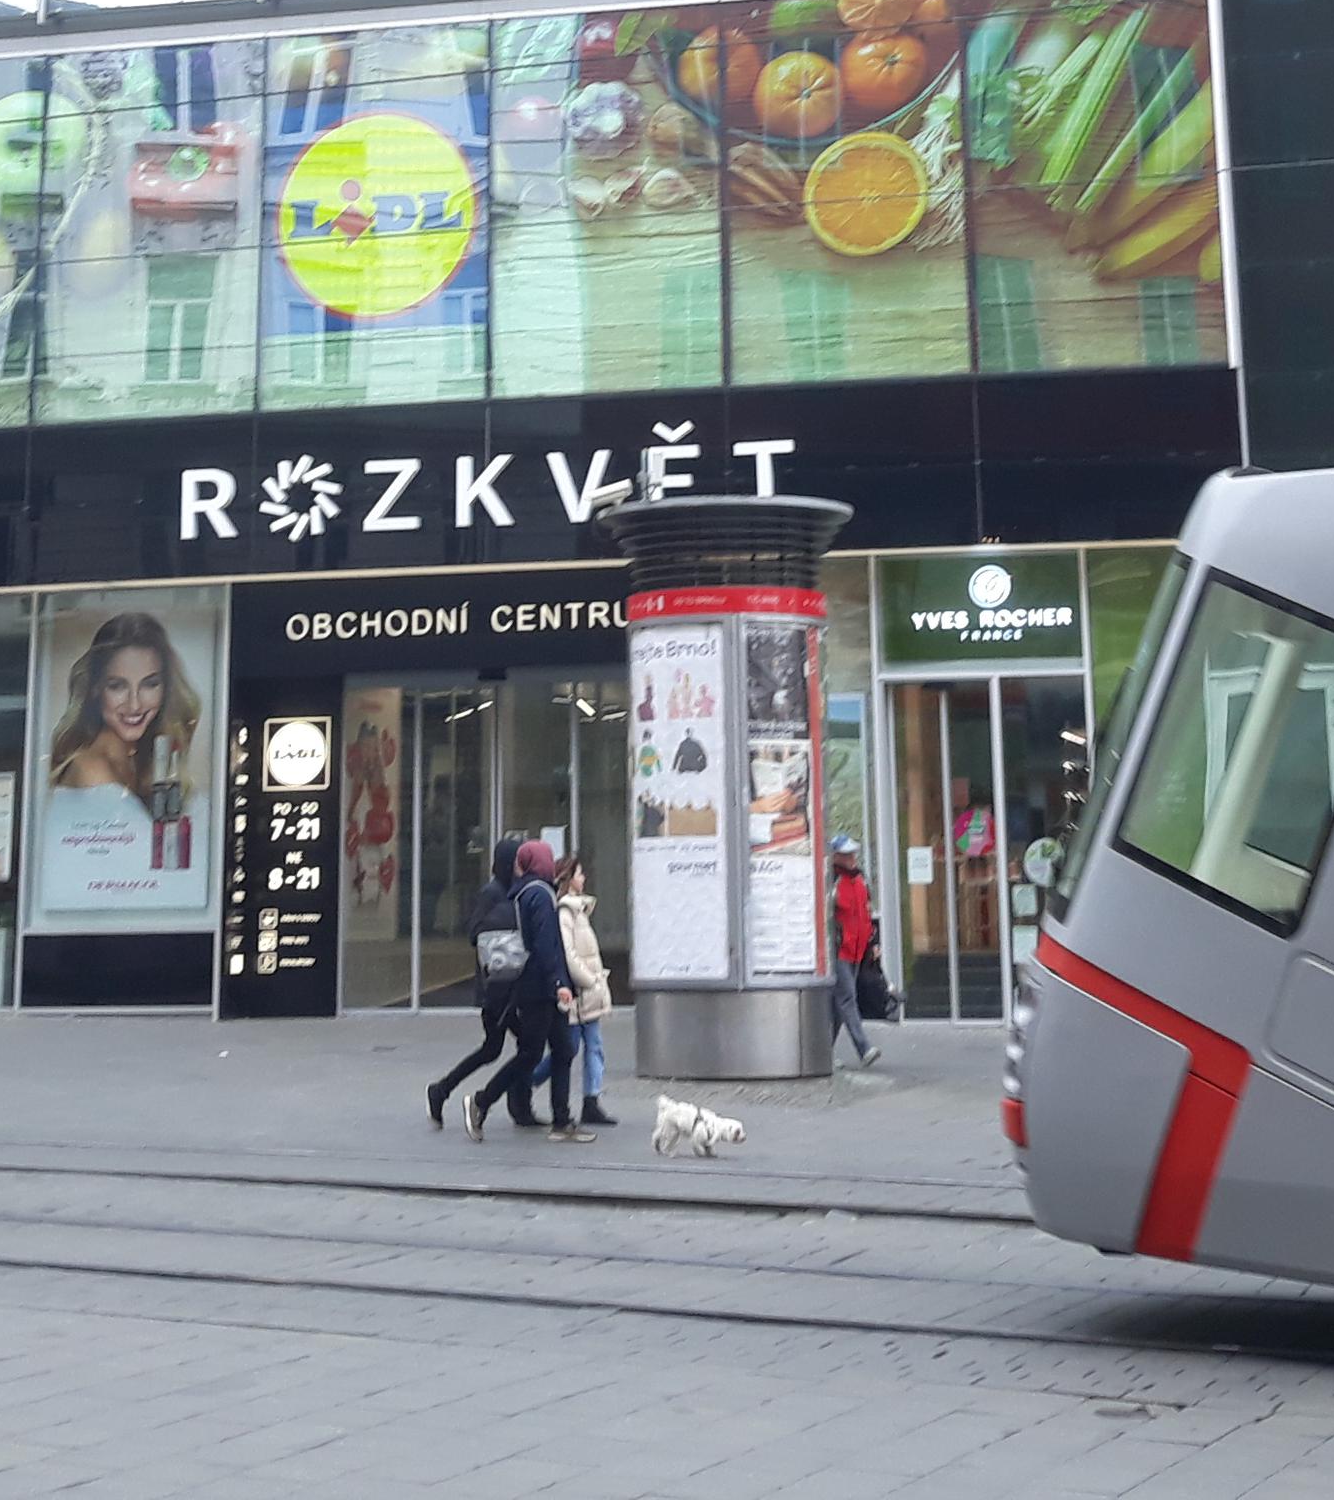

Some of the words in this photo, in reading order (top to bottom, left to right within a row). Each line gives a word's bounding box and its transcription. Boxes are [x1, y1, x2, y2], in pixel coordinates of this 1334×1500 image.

[285, 601, 469, 641] OBCHODNÍ
[490, 600, 630, 633] CENTRU
[911, 610, 969, 631] YVES
[979, 607, 1073, 629] ROCHER
[960, 628, 1024, 642] FRANCE
